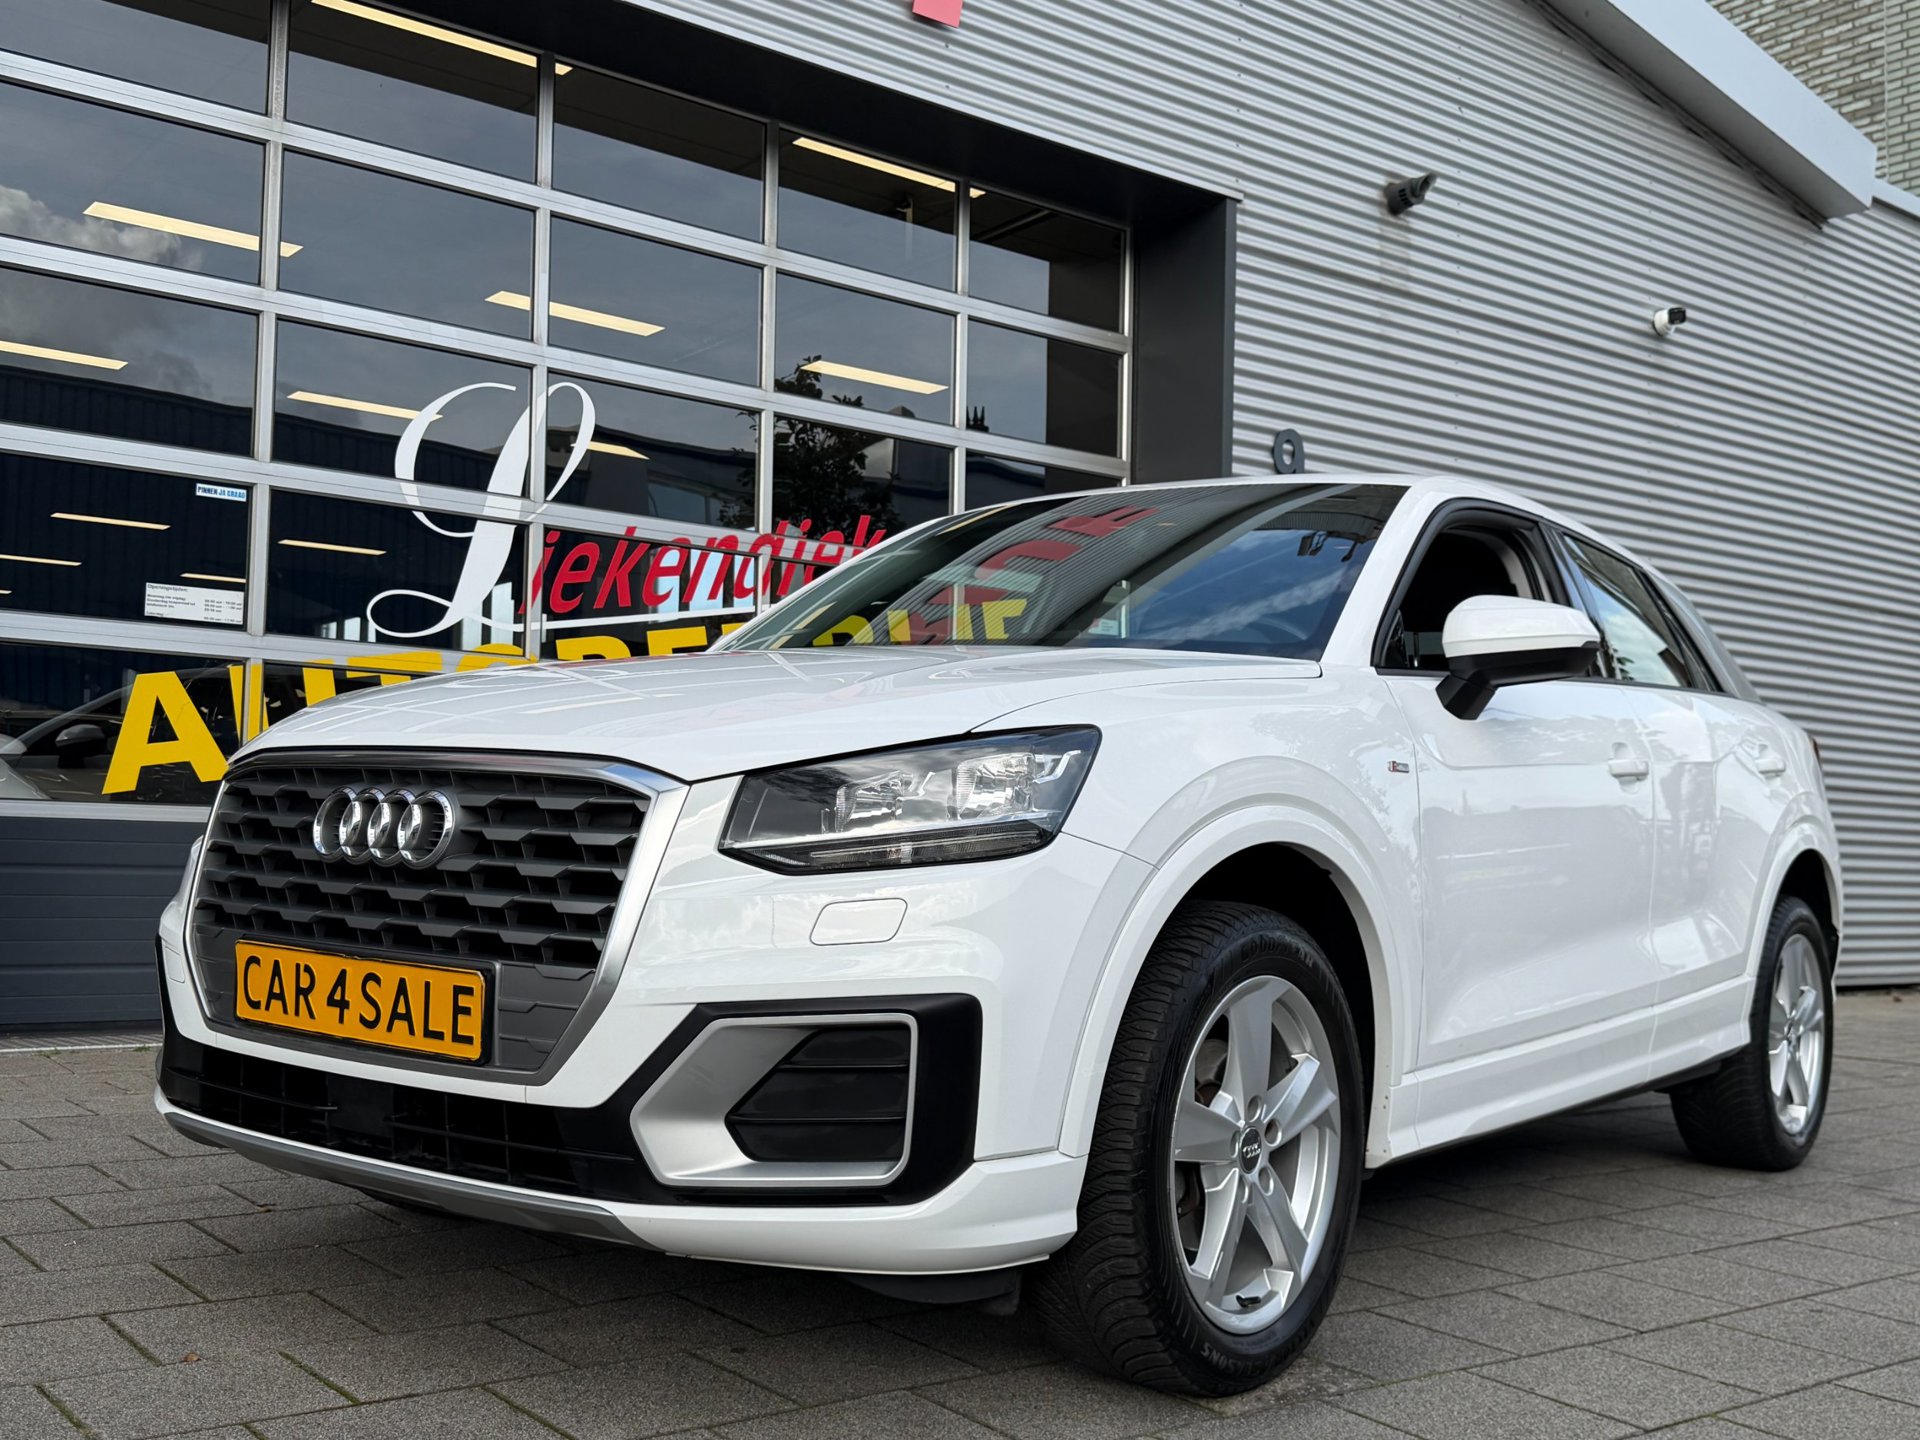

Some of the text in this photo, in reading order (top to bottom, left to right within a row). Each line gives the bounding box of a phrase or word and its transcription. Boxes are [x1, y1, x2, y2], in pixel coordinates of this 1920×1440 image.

[243, 955, 475, 1046] CAR 4 SALE
